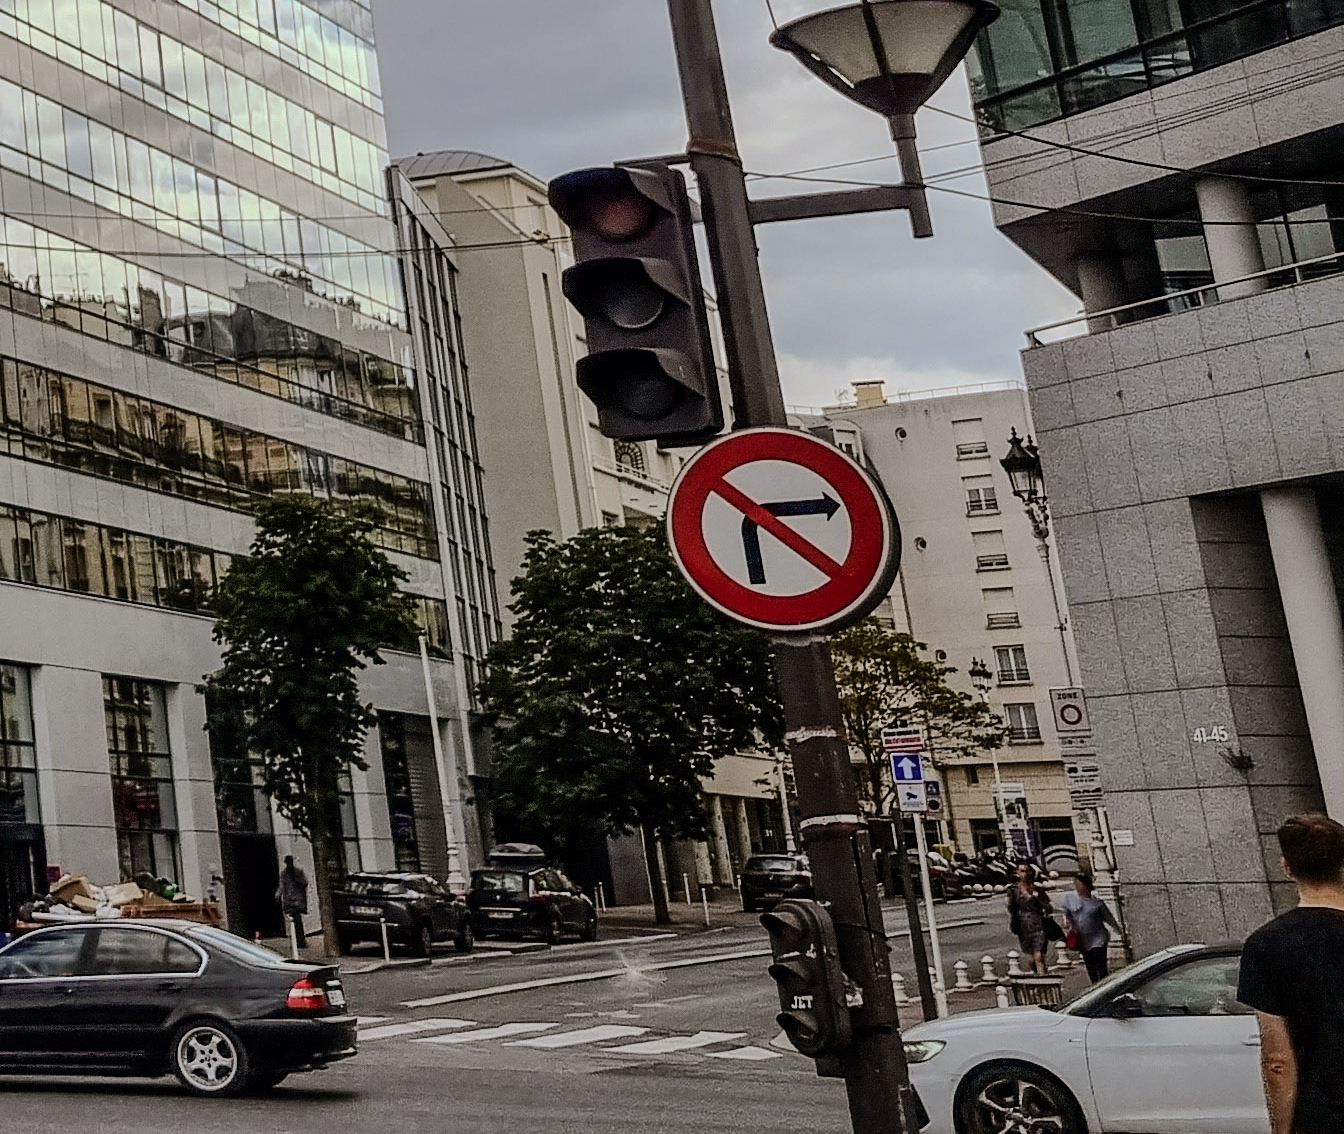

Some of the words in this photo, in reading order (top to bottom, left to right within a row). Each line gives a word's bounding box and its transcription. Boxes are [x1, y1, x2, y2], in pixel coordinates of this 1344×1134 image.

[1055, 692, 1079, 700] ZONE
[1193, 725, 1229, 743] 41-45
[790, 995, 814, 1010] JET
